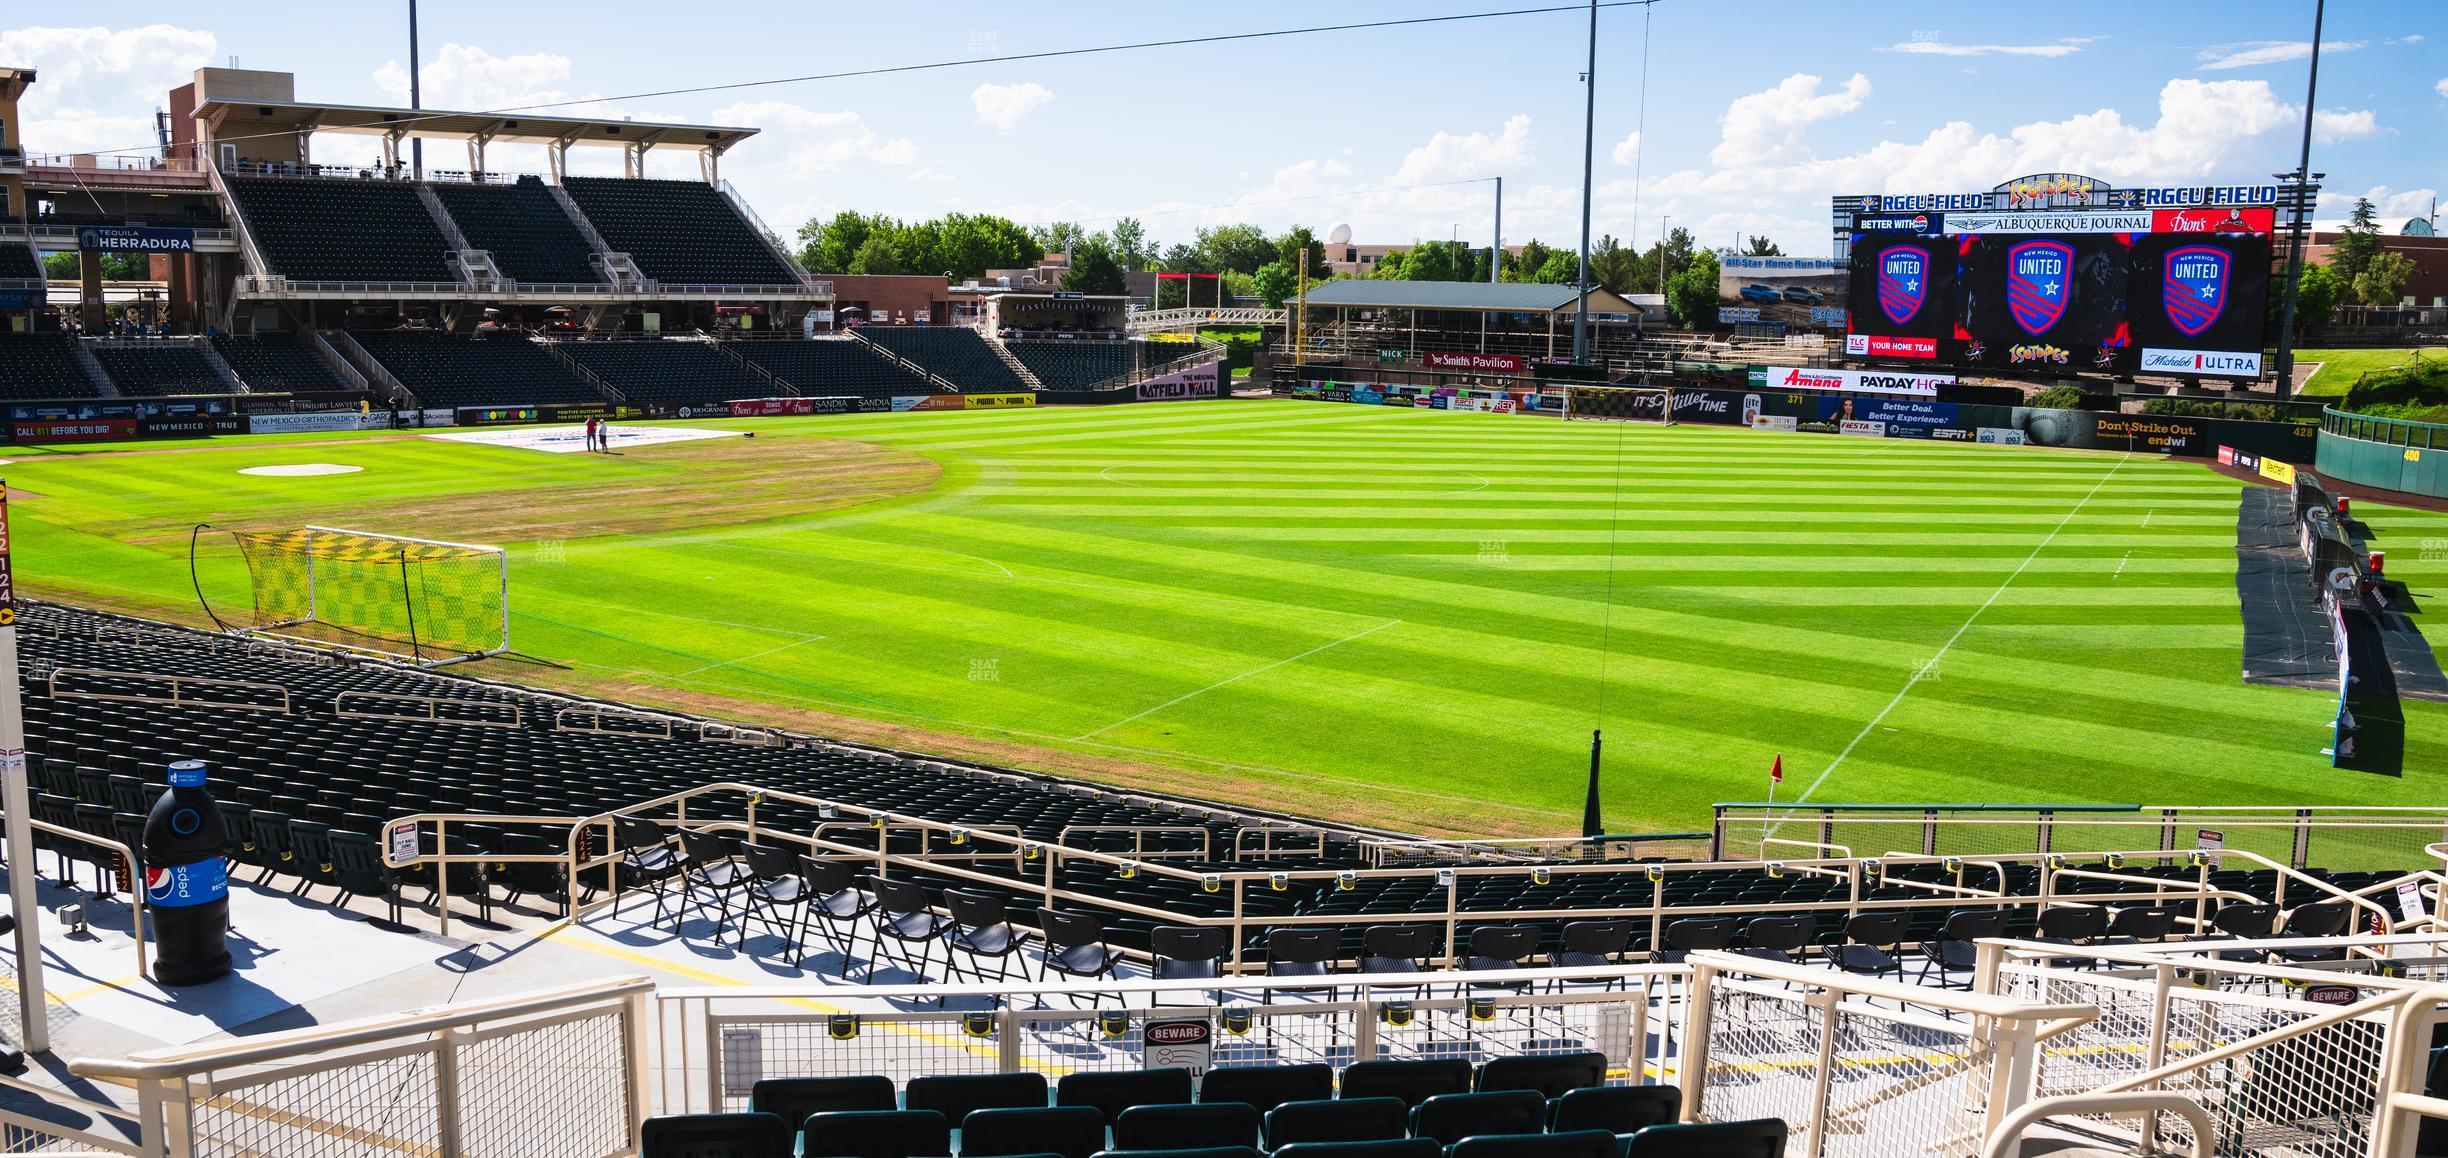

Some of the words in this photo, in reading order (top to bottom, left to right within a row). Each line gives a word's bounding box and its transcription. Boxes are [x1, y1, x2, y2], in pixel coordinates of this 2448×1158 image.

[2145, 186, 2203, 205] RGCU
[2214, 186, 2277, 204] FIELD
[1882, 195, 1927, 210] RGCU
[1935, 194, 1983, 209] FIELD
[1861, 220, 1892, 229] BETTER
[1894, 219, 1915, 229] WITH
[1995, 217, 2088, 231] ALBUQUERQUE
[2090, 217, 2150, 231] JOURNAL
[2170, 210, 2206, 232] Dion's
[100, 238, 191, 249] HERRADURA
[1725, 258, 1763, 268] All-Star
[1765, 259, 1793, 268] Home
[1794, 260, 1814, 269] Run
[1887, 261, 1920, 274] UNITED
[2019, 259, 2062, 275] UNITED
[2175, 263, 2218, 279] UNITED
[1850, 338, 1865, 346] TLC
[1872, 341, 1891, 349] YOUR
[1892, 343, 1912, 351] HOME
[1914, 344, 1934, 352] TEAM
[1443, 354, 1470, 366] Smith's
[1473, 356, 1513, 369] Pavilion
[2145, 354, 2194, 367] Michelob
[2205, 356, 2256, 371] ULTRA
[1784, 369, 1842, 388] Amana
[1860, 376, 1916, 390] PAYDAY
[1139, 383, 1185, 398] OATFIELD
[1188, 382, 1216, 396] WALL
[815, 400, 848, 408] SANDIA
[858, 398, 890, 407] SANDIA
[976, 397, 995, 405] PUMA
[1006, 397, 1024, 405] PUMA
[1634, 396, 1655, 407] IT'S
[1699, 401, 1728, 412] TIME
[1745, 398, 1760, 409] Lite
[1788, 395, 1803, 405] 371
[302, 402, 327, 410] INJURY
[1882, 402, 1910, 410] Better
[1911, 404, 1933, 412] Deal.
[270, 417, 300, 425] MEXICO
[301, 415, 357, 424] ORTHOPAEDICS
[508, 410, 538, 419] WOLF
[1868, 412, 1896, 420] Better
[17, 427, 35, 436] CALL
[51, 426, 79, 435] BEFORE
[79, 425, 94, 434] YOU
[95, 425, 110, 434] DIG!
[171, 422, 204, 430] MEXICO
[216, 421, 238, 429] TRUE
[1841, 422, 1869, 430] FIESTA
[2097, 420, 2129, 430] Don't
[2131, 422, 2168, 433] Strike
[2170, 424, 2197, 436] Out.
[2292, 427, 2313, 437] 428
[2147, 436, 2186, 447] endwi
[2403, 449, 2420, 462] 400
[177, 866, 191, 898] peps
[212, 880, 228, 891] RECYC
[2313, 991, 2349, 1001] BEWARE
[1155, 1027, 1200, 1039] BEWARE
